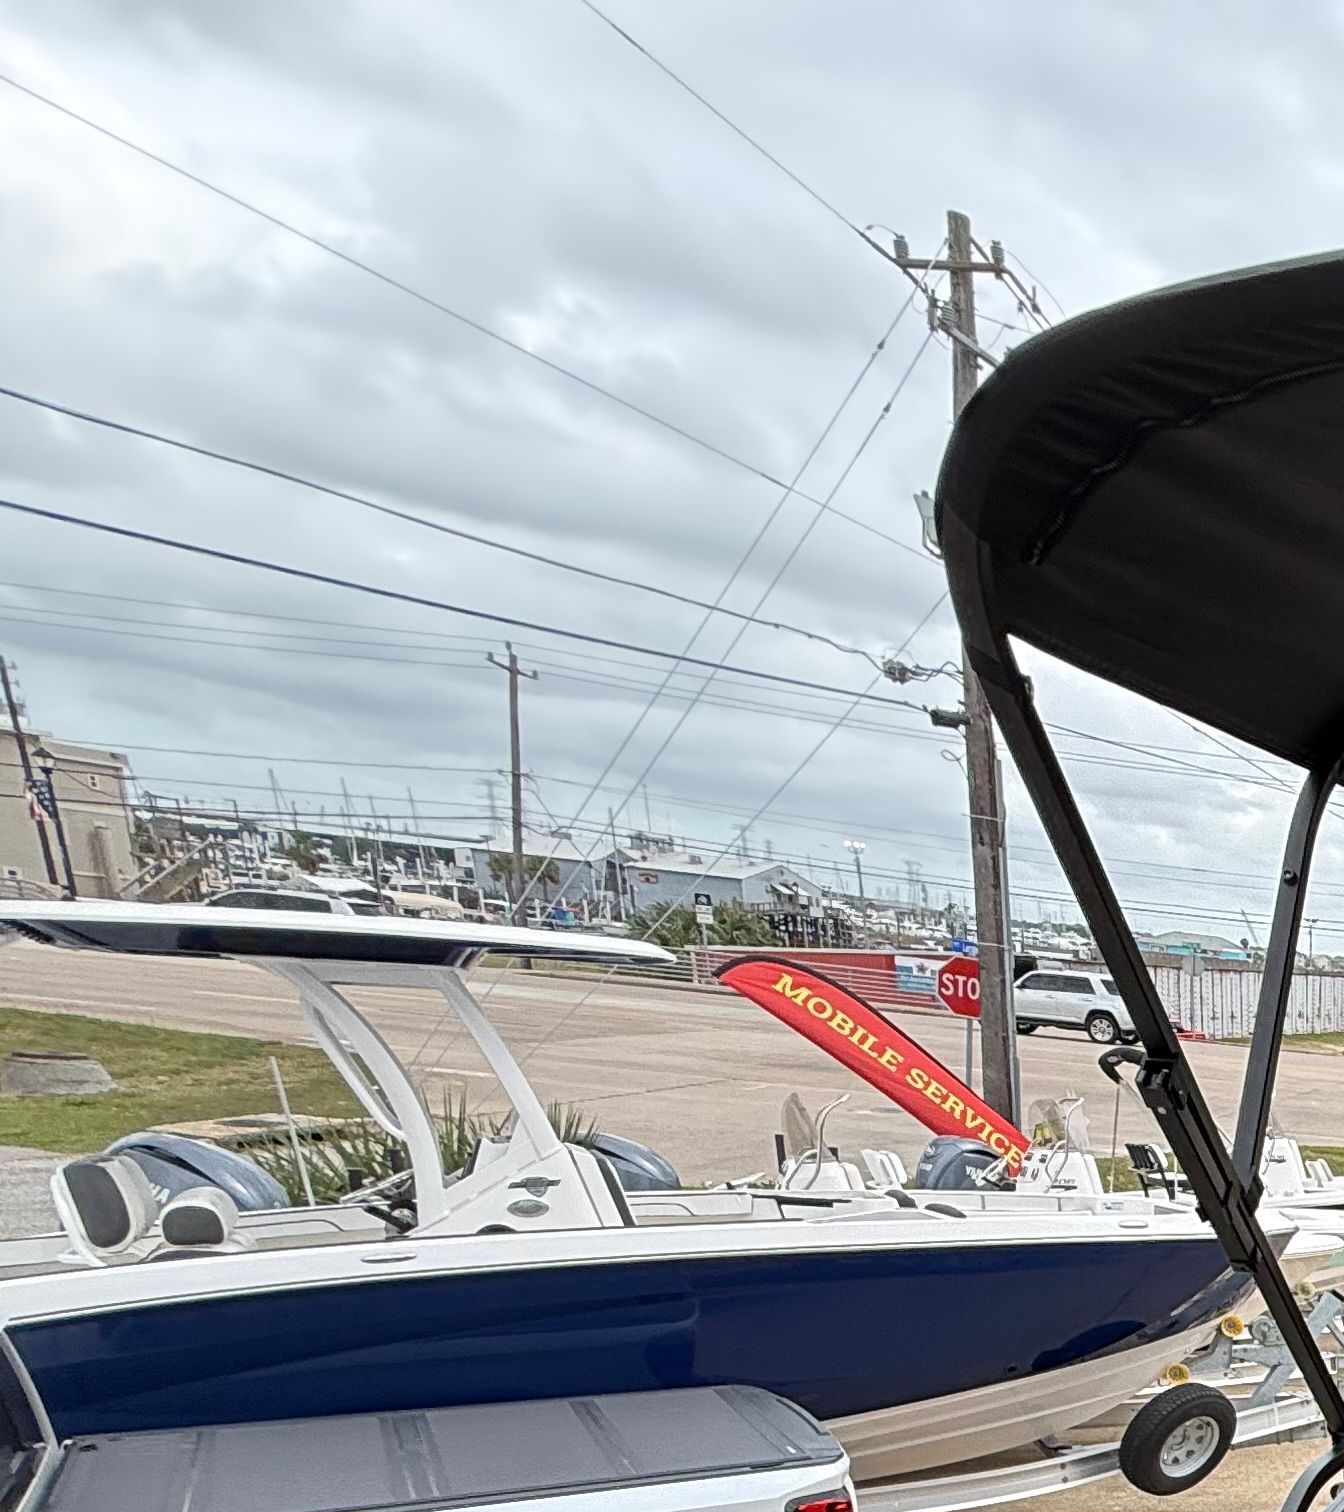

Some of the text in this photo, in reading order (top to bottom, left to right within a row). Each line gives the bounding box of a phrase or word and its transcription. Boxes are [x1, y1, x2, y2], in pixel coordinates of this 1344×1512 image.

[940, 973, 980, 1000] STO
[771, 972, 1025, 1169] MOBILE SERVICE
